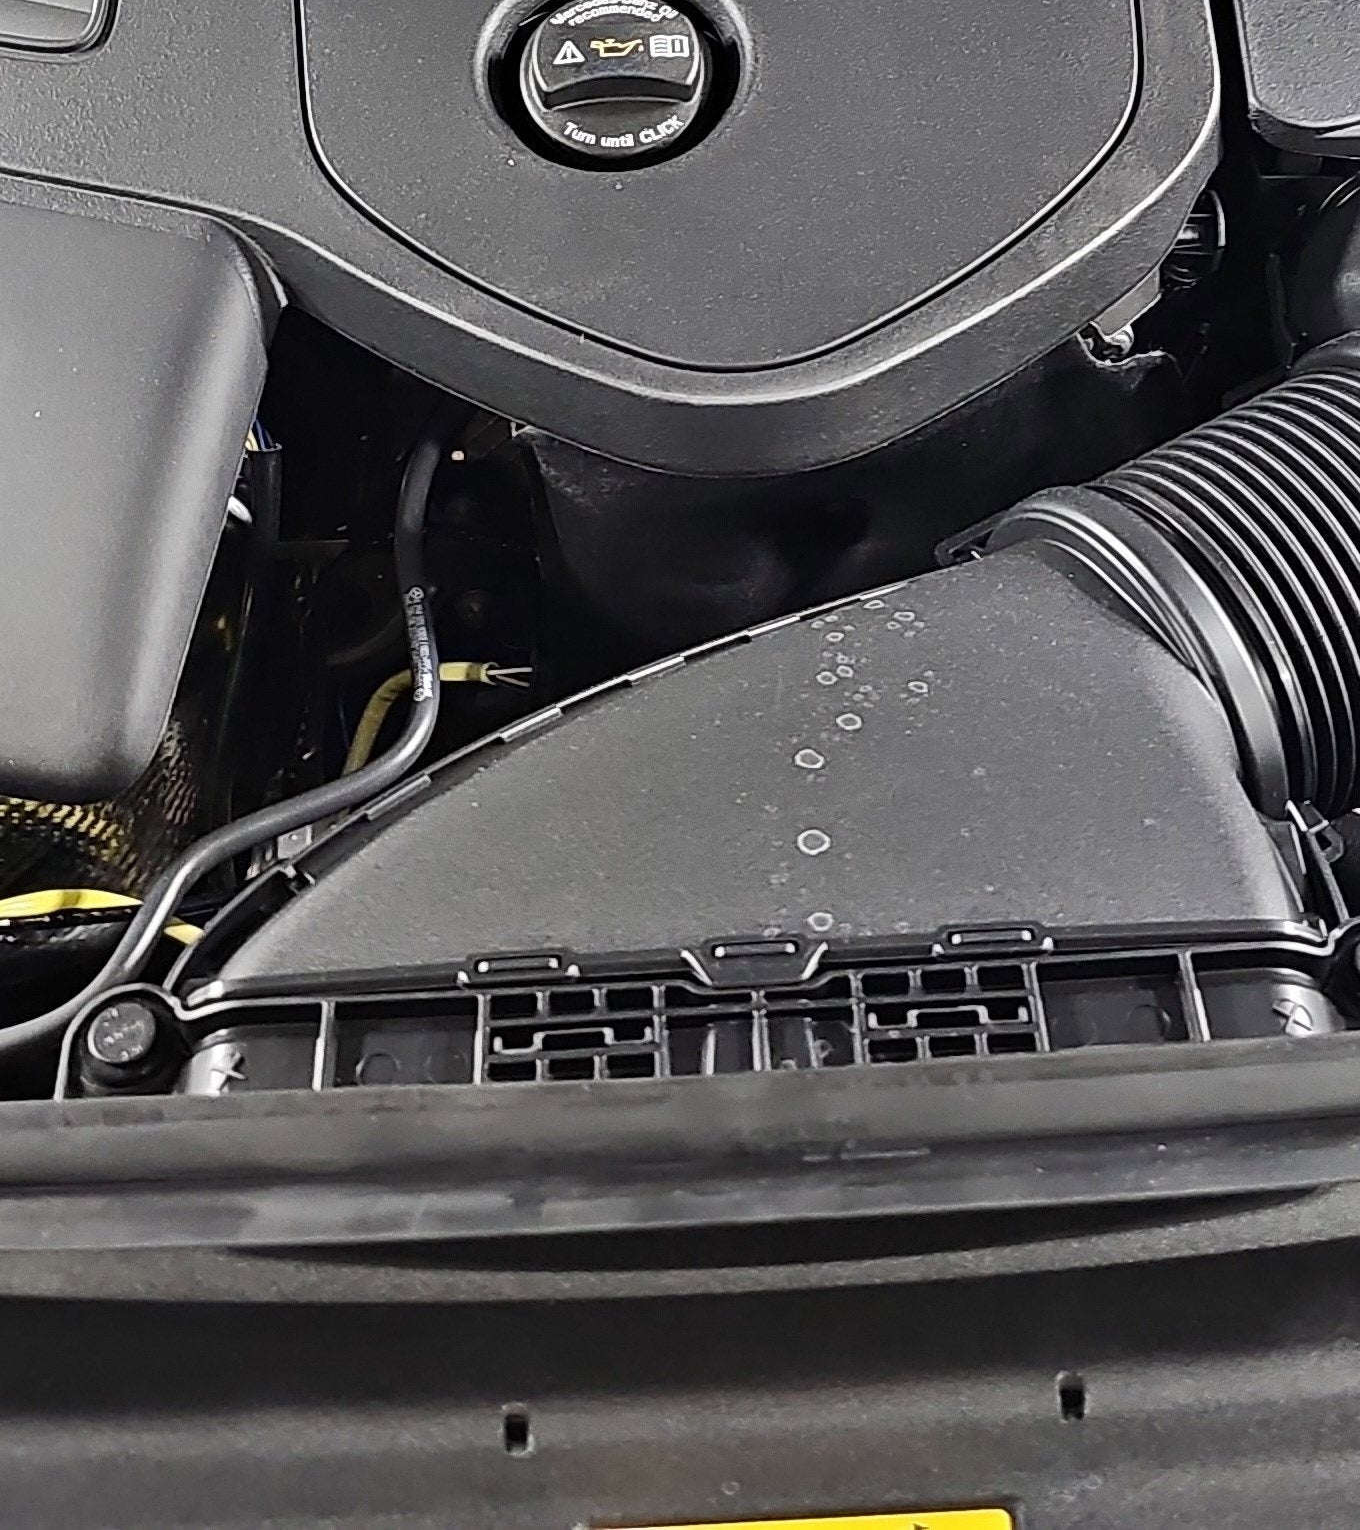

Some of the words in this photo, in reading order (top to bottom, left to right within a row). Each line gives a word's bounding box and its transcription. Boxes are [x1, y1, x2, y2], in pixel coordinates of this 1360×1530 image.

[568, 4, 664, 27] recommended
[659, 4, 680, 20] Oil
[563, 121, 596, 145] Turn
[600, 133, 635, 148] until
[639, 114, 685, 144] CLICK
